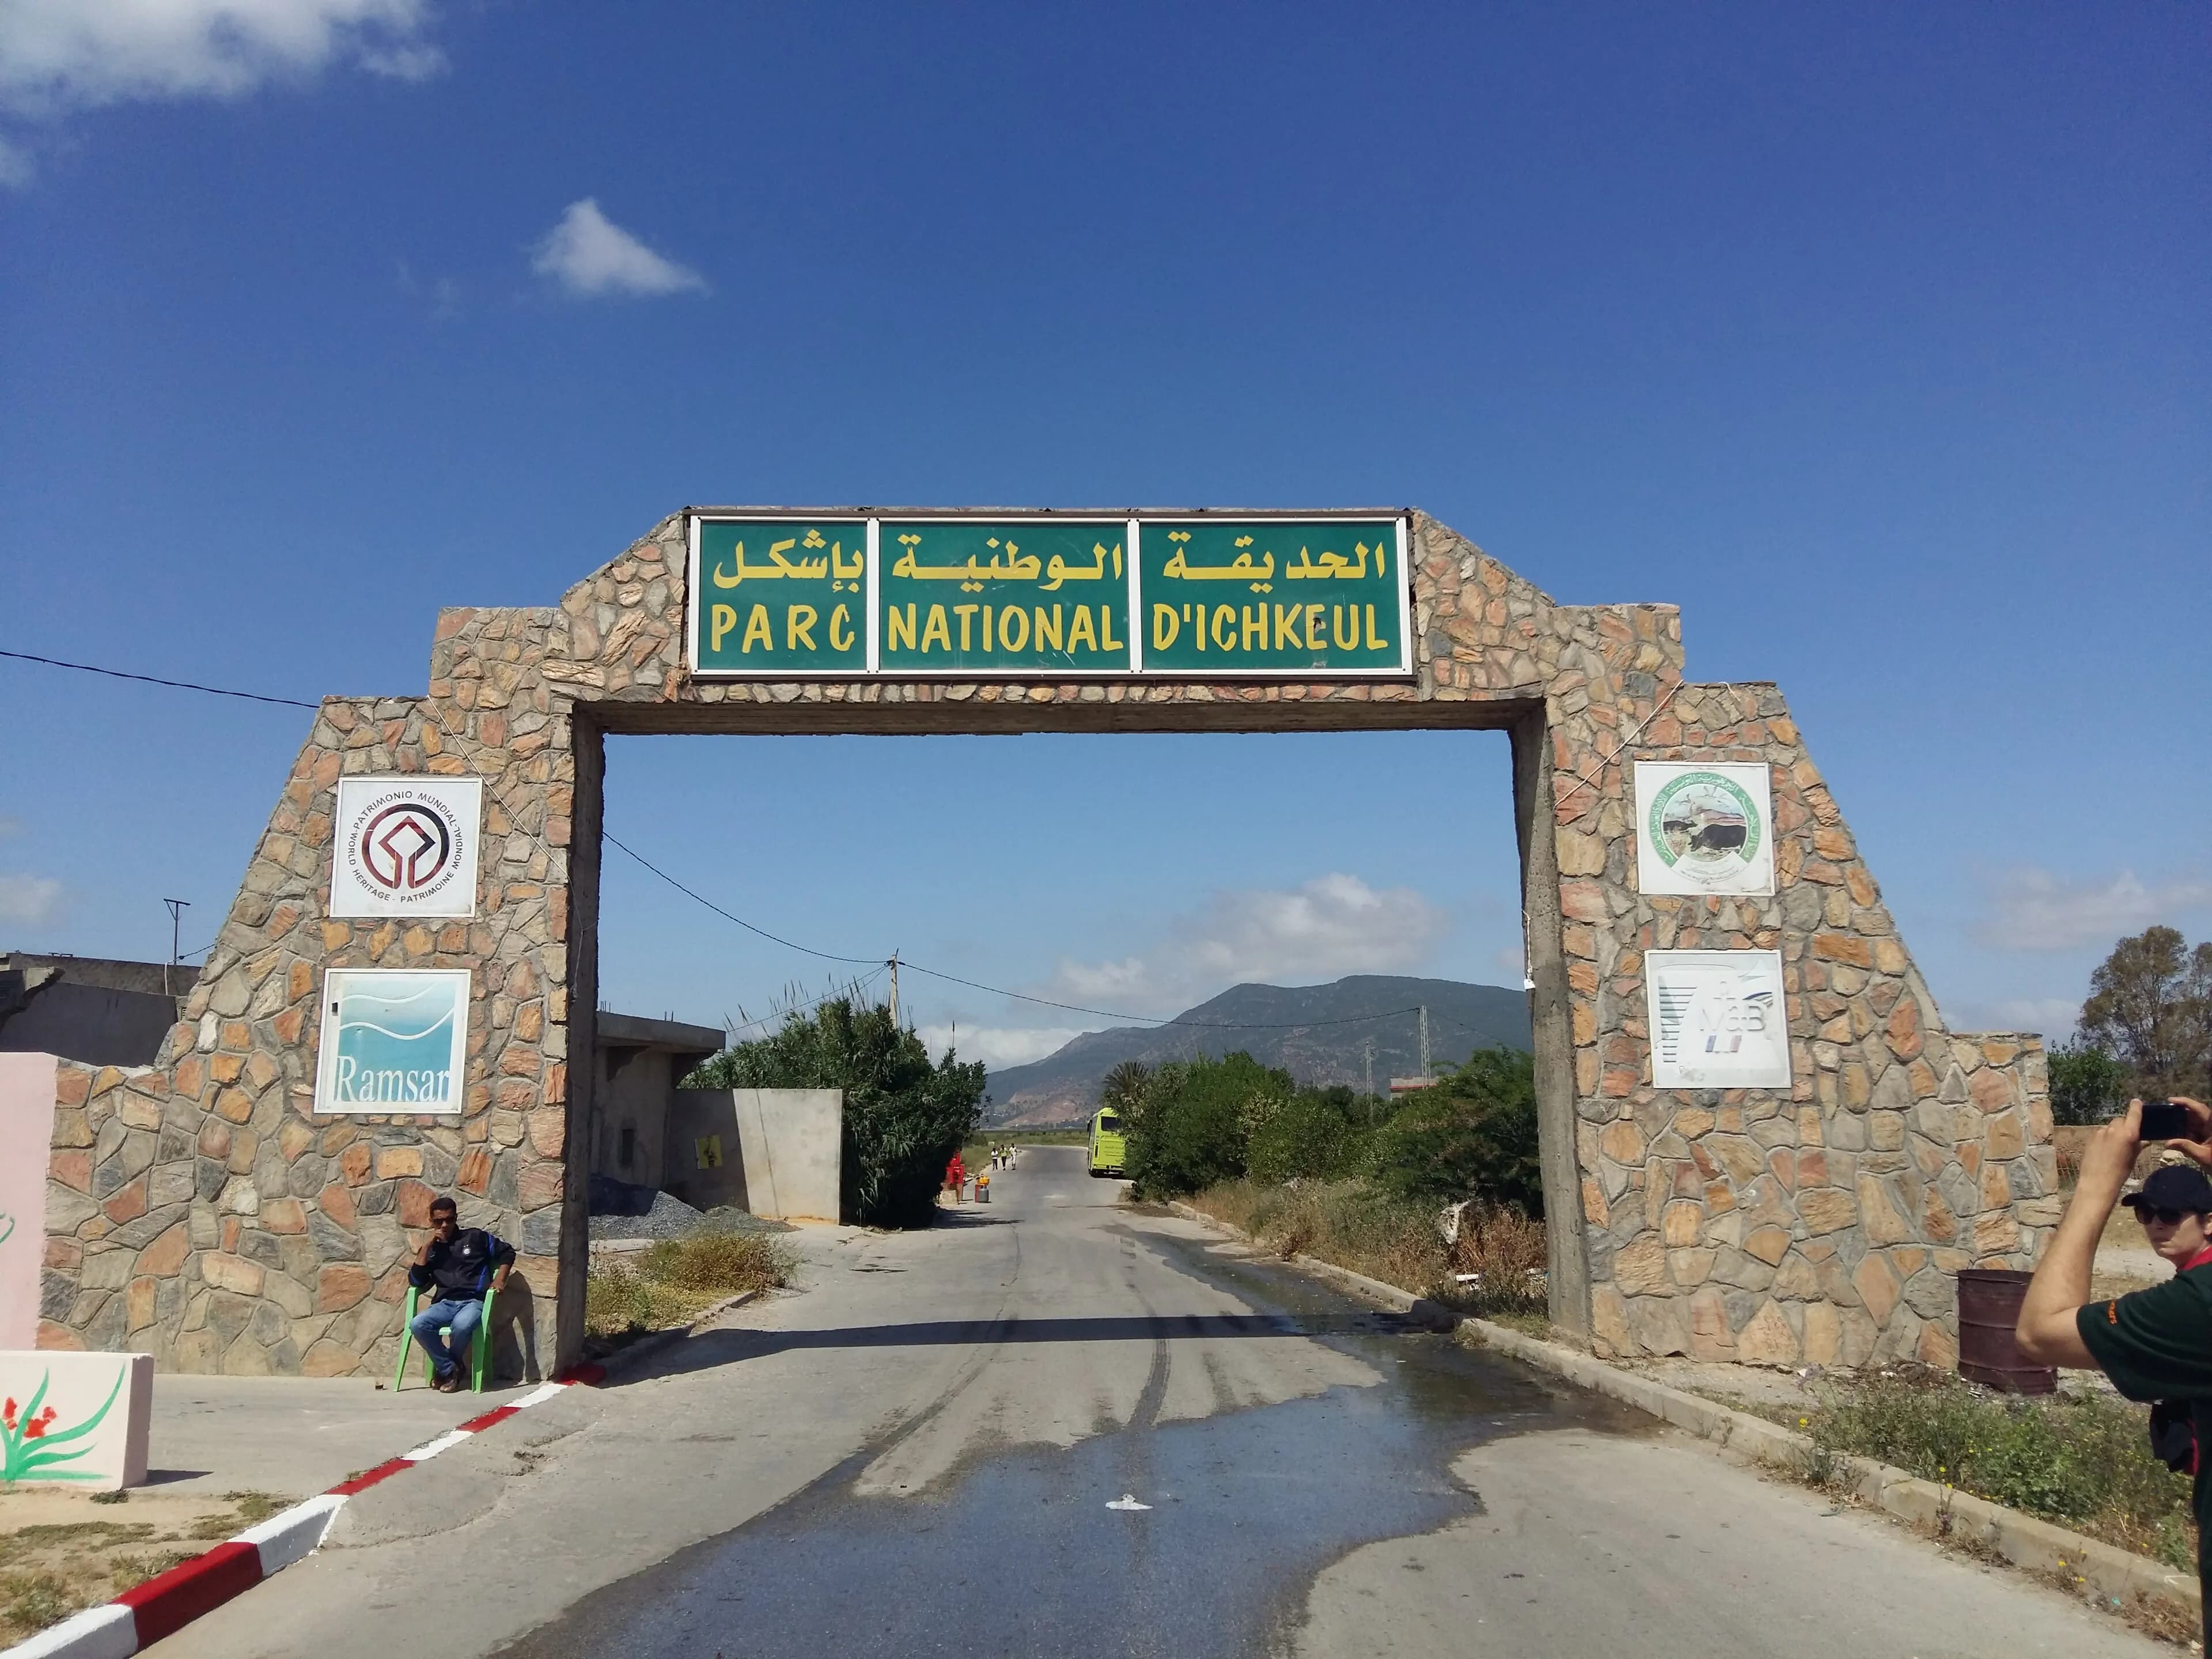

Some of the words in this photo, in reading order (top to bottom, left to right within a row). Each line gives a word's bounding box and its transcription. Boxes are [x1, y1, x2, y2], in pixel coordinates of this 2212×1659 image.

[713, 529, 863, 593] بإشكل
[892, 534, 1122, 592] الوطنية
[1163, 531, 1385, 593] الحديقة
[711, 604, 855, 654] PARC
[888, 603, 1124, 653] NATIONAL
[1153, 602, 1389, 652] D'ICHKEUL
[354, 791, 412, 830] PATRIMONIO
[418, 793, 457, 826] MUNDIAL
[348, 831, 358, 865] WORLD
[353, 869, 391, 901] HERITAGE
[400, 871, 454, 903] PATRIMOINE
[452, 827, 463, 870] MONDIAL
[334, 1056, 449, 1101] Ramsar
